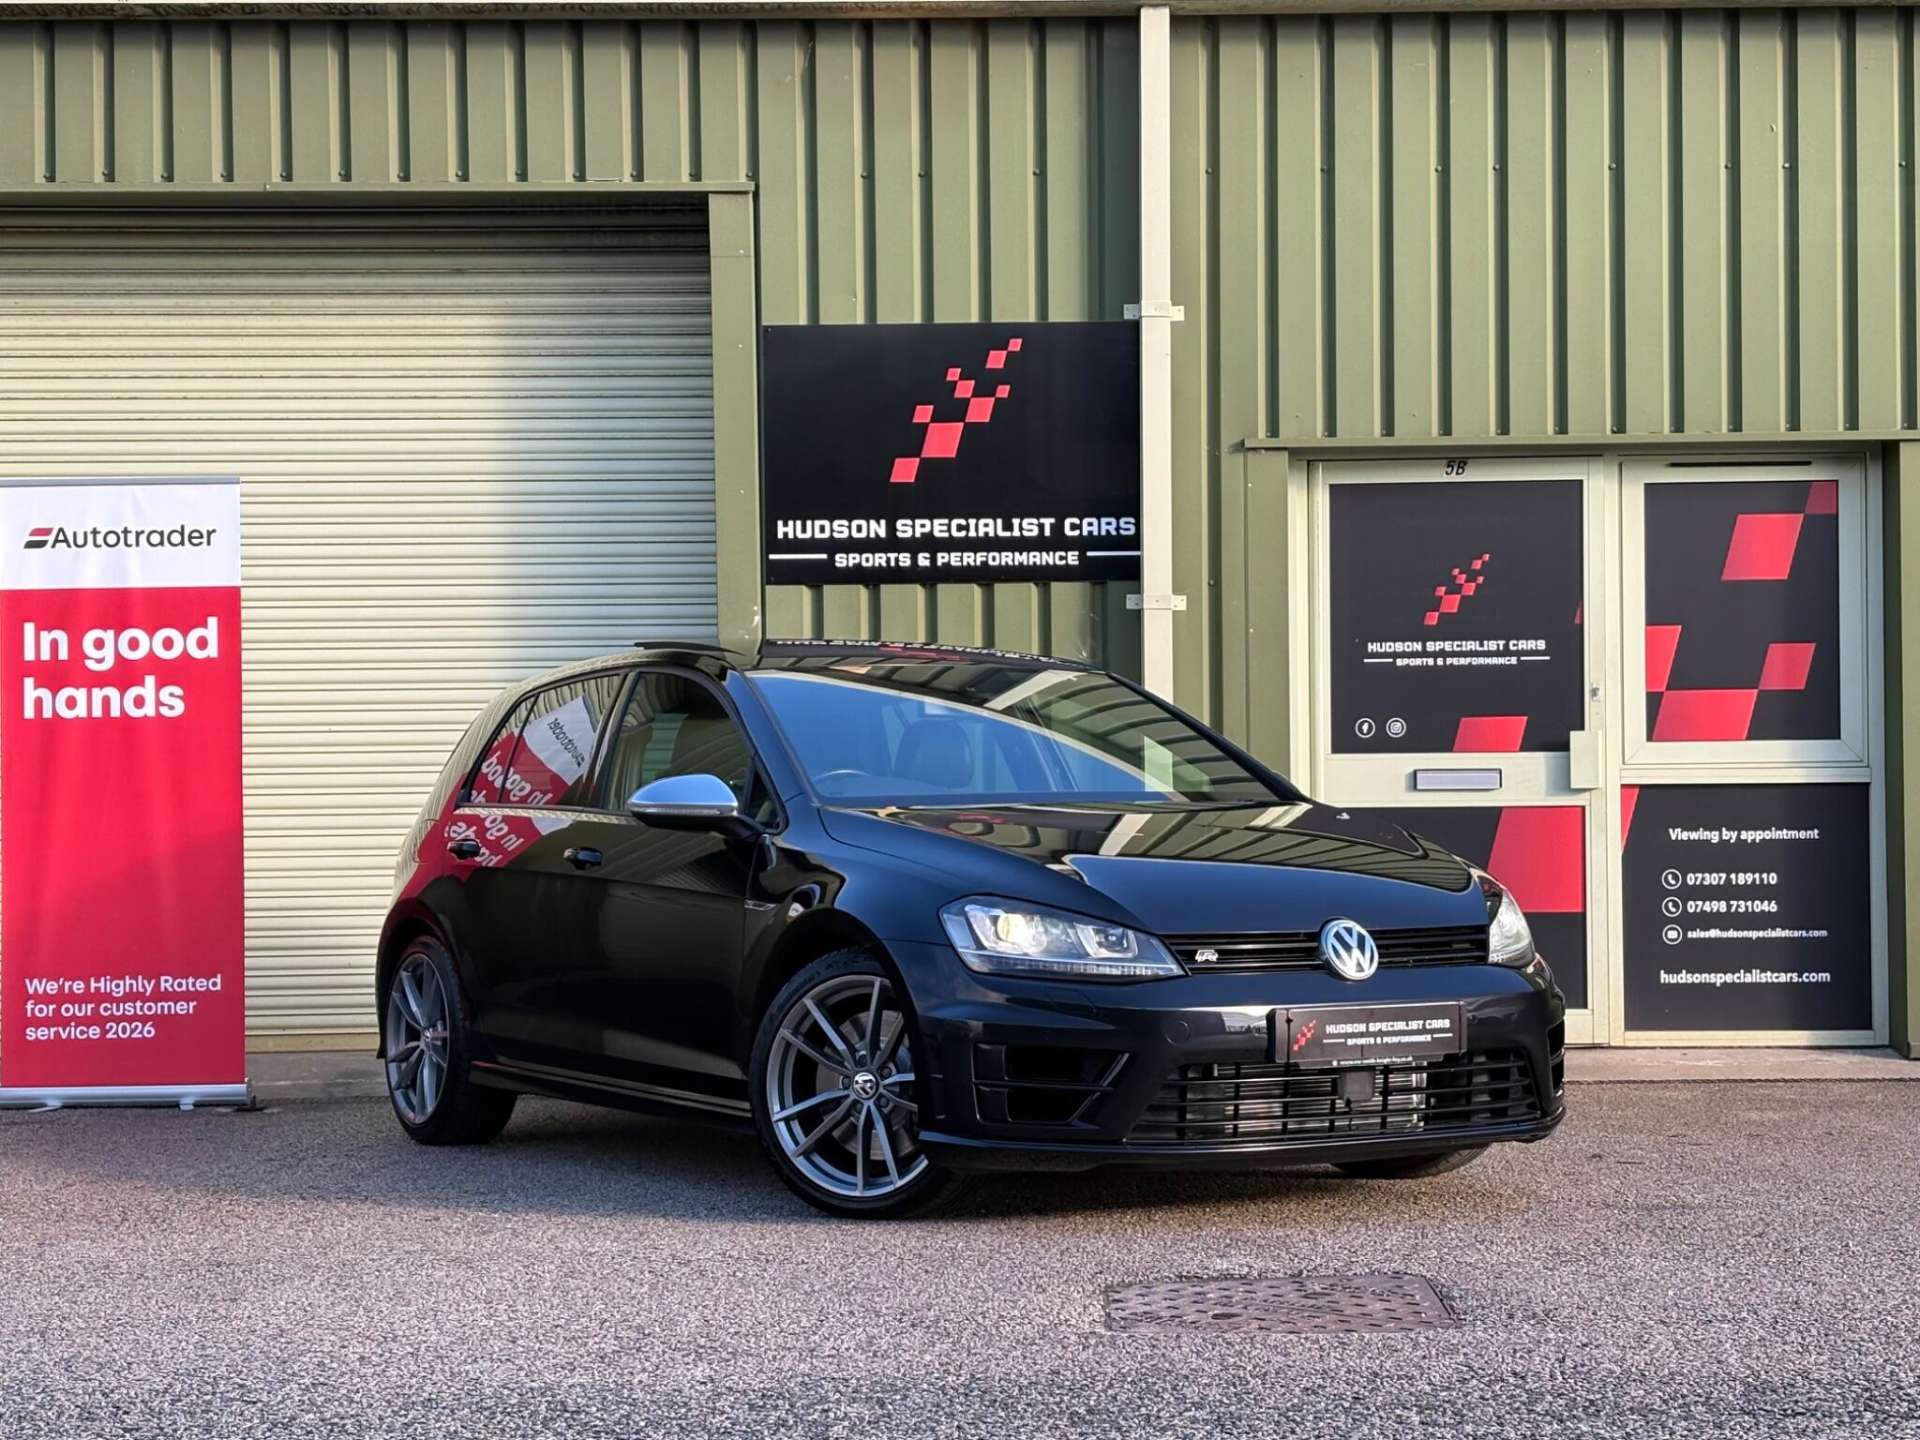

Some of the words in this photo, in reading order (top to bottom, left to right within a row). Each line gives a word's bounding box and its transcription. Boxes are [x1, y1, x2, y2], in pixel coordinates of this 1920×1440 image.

[1445, 460, 1467, 476] 5B
[51, 524, 217, 549] Autotrader
[777, 519, 887, 539] HUDSON
[896, 518, 1055, 538] SPECIALIST
[1064, 517, 1136, 536] CARS
[835, 552, 911, 568] SPORTS
[917, 552, 931, 567] &
[937, 551, 1079, 567] PERFORMANCE
[23, 622, 69, 661] In
[82, 616, 219, 672] good
[1368, 641, 1422, 653] HUDSON
[1426, 640, 1505, 652] SPECIALIST
[1509, 639, 1546, 650] CARS
[1396, 658, 1434, 666] SPORTS
[1446, 656, 1518, 666] PERFORMANCE
[23, 674, 185, 719] hands
[1669, 827, 1720, 843] Viewing
[1722, 827, 1738, 843] by
[1740, 827, 1820, 843] appointment
[1686, 873, 1727, 886] 07307
[1730, 872, 1778, 885] 189110
[1686, 901, 1727, 913] 07498
[1730, 901, 1778, 913] 731046
[1687, 928, 1828, 941] sales@hudsonspecialistcars.com
[90, 976, 155, 997] Highly
[160, 974, 222, 992] Rated
[1660, 970, 1831, 987] hudsonspecialistcars.com
[26, 1000, 57, 1018] for
[60, 1001, 95, 1017] our
[100, 999, 197, 1016] customer
[26, 1022, 101, 1041] service
[105, 1022, 156, 1039] 2026
[1326, 1023, 1366, 1034] HUDSON
[1368, 1020, 1424, 1032] SPECIALIST
[1426, 1019, 1450, 1029] CARS
